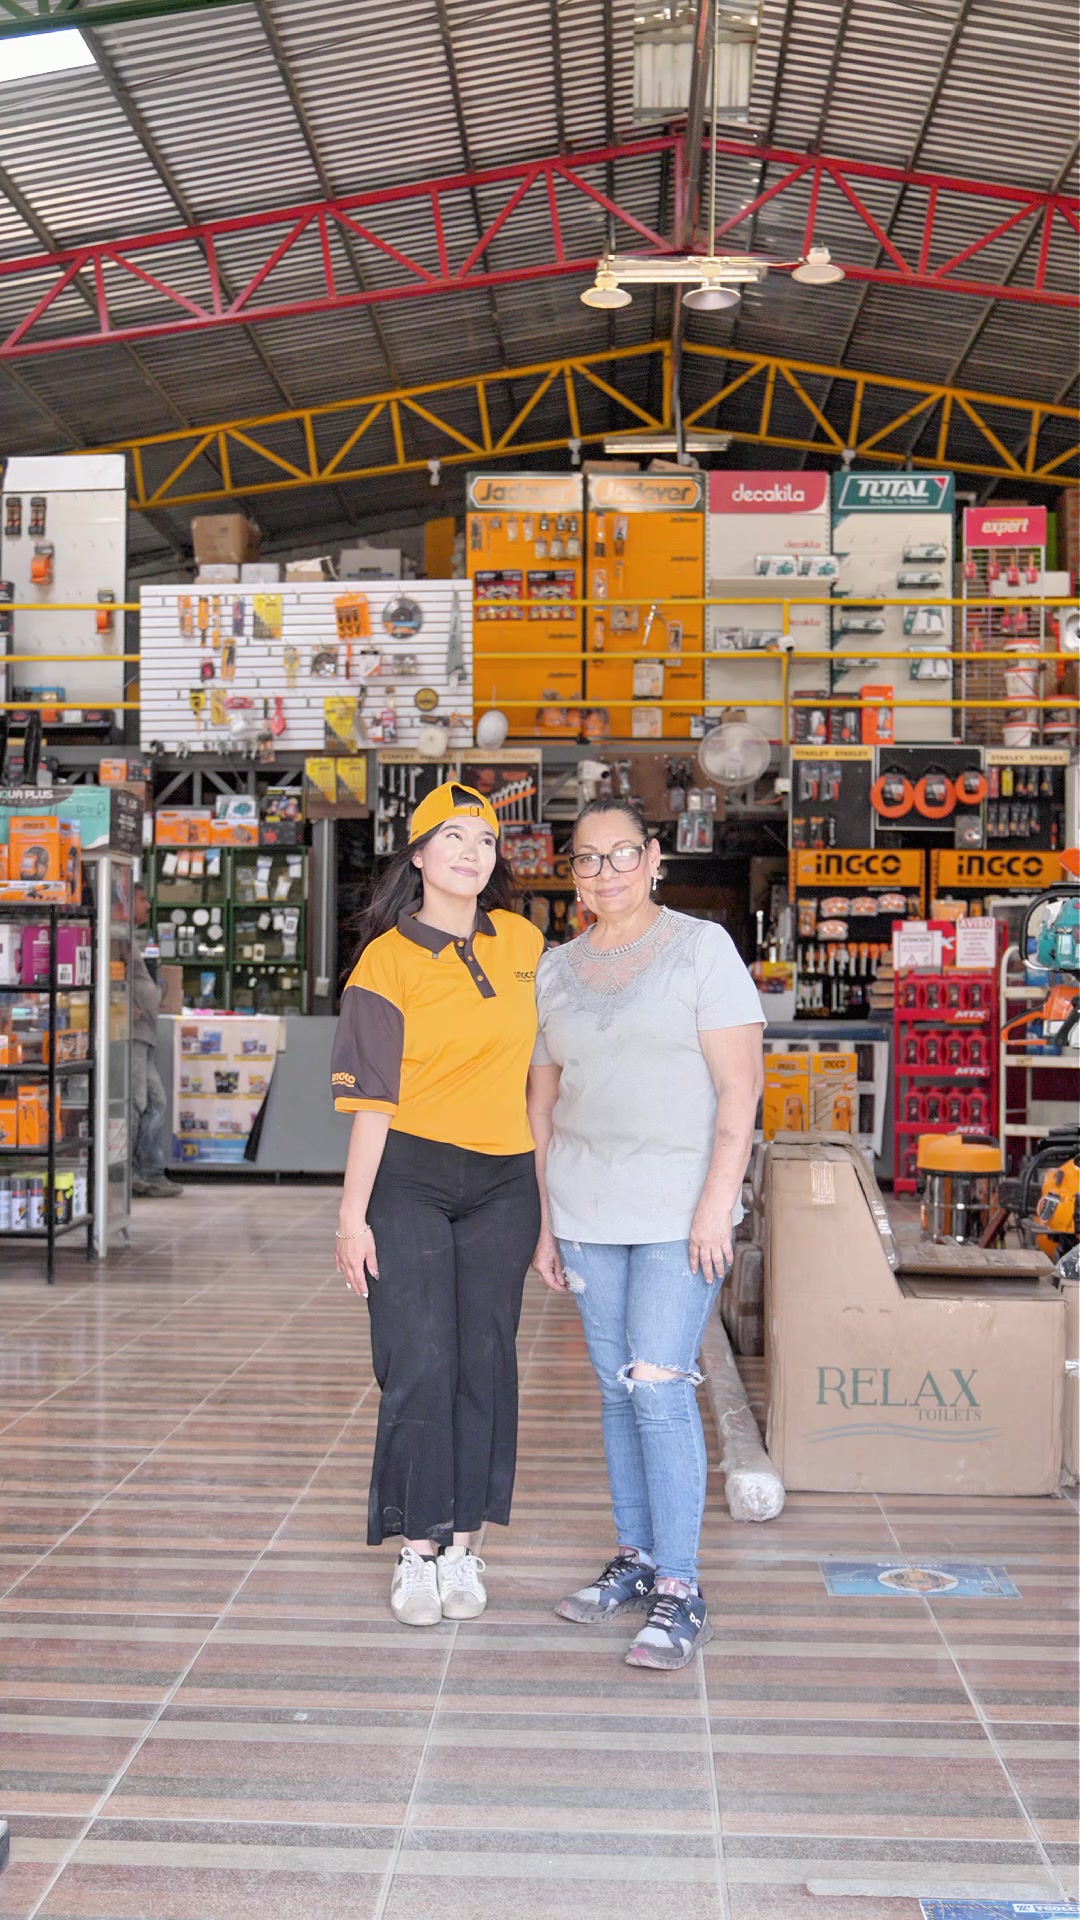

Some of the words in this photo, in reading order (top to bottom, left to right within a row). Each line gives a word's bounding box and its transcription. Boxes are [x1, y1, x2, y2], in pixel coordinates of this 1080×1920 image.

[602, 481, 692, 502] Jadever
[731, 483, 805, 503] decakila
[857, 479, 930, 498] TOTAL
[981, 517, 1029, 537] expert
[0, 789, 23, 800] QUA
[24, 789, 54, 800] PLUS
[954, 1010, 985, 1019] MTX
[954, 1066, 985, 1076] MTX
[816, 1366, 981, 1410] RELAX
[915, 1408, 982, 1422] TOILETS
